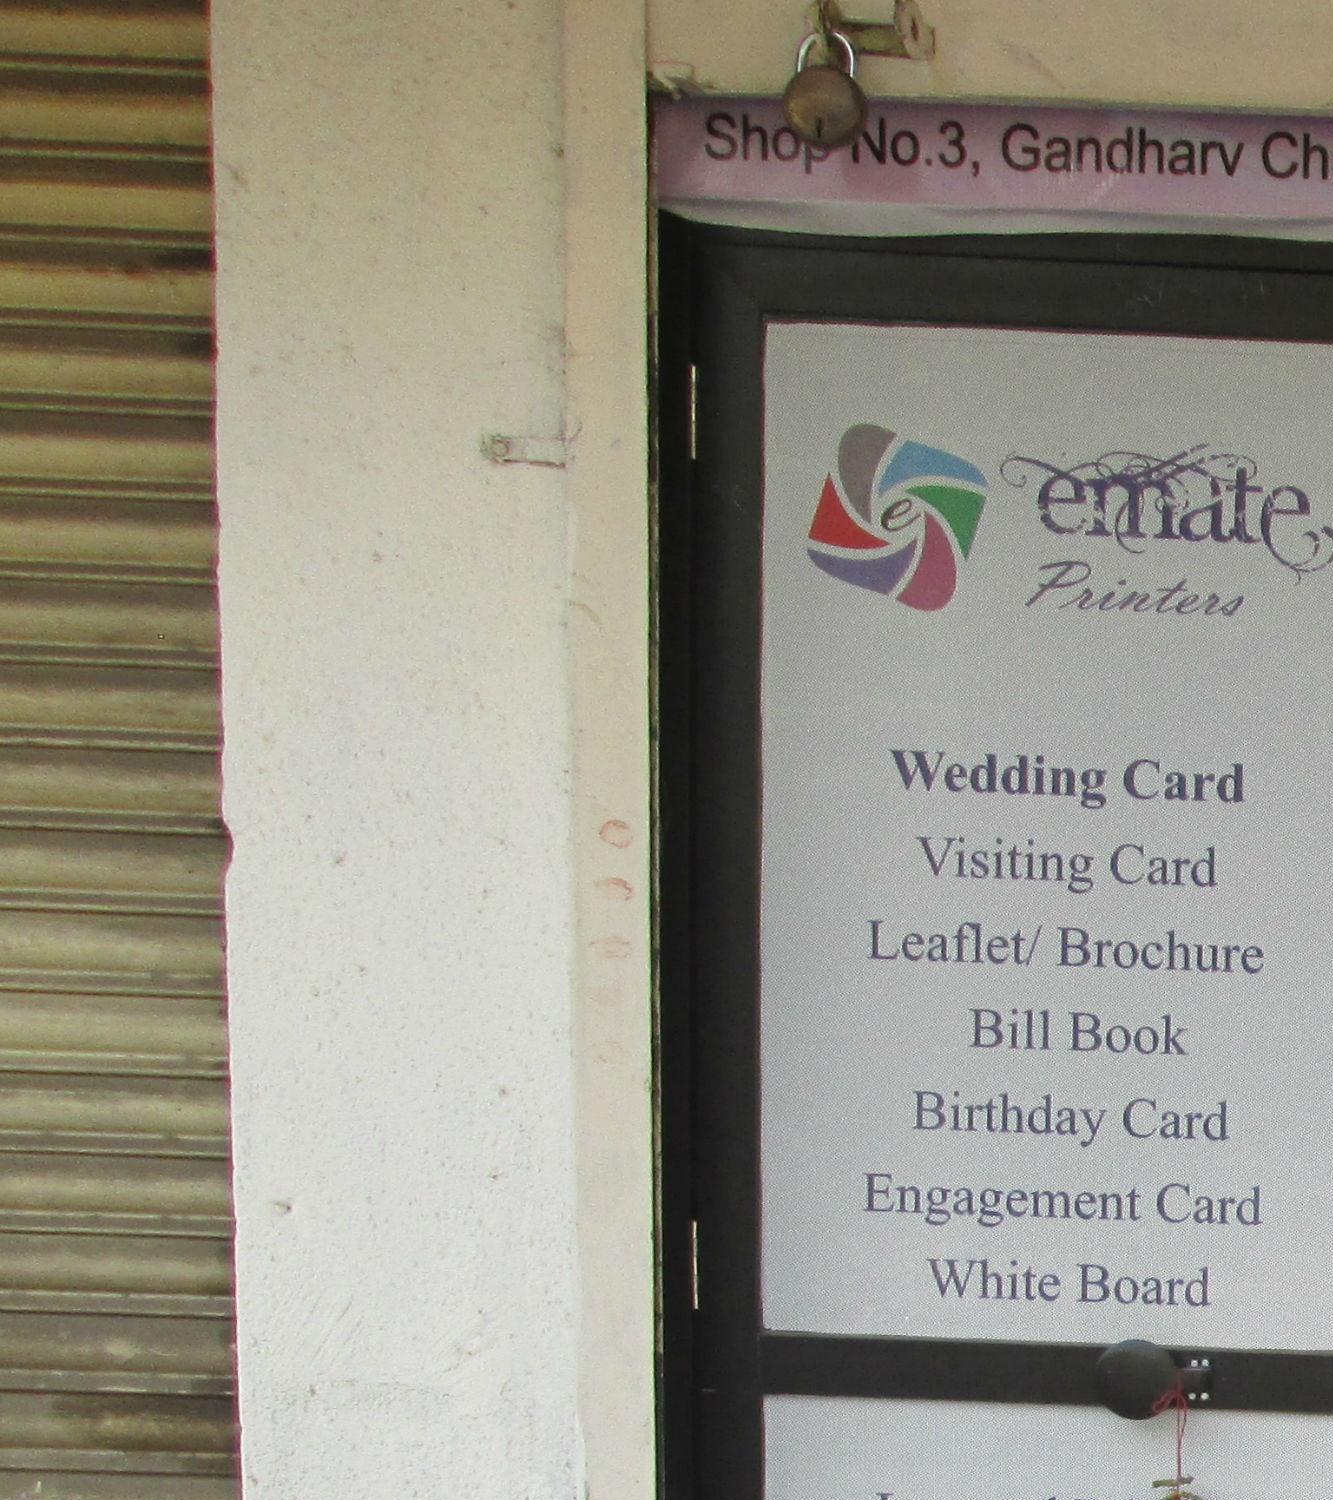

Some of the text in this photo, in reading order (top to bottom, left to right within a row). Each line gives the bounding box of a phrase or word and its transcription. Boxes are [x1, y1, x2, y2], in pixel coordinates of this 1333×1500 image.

[1001, 122, 1244, 178] Gandharv
[1026, 560, 1246, 618] Printers
[890, 748, 1246, 810] Wedding Card
[916, 836, 1219, 894] Visiting Card
[867, 919, 1266, 975] Leaflet/ Brochure
[969, 1007, 1190, 1056] Bill Book
[912, 1089, 1230, 1148] Birthday Card
[863, 1172, 1263, 1228] Engagement Card
[926, 1257, 1212, 1307] White Board
